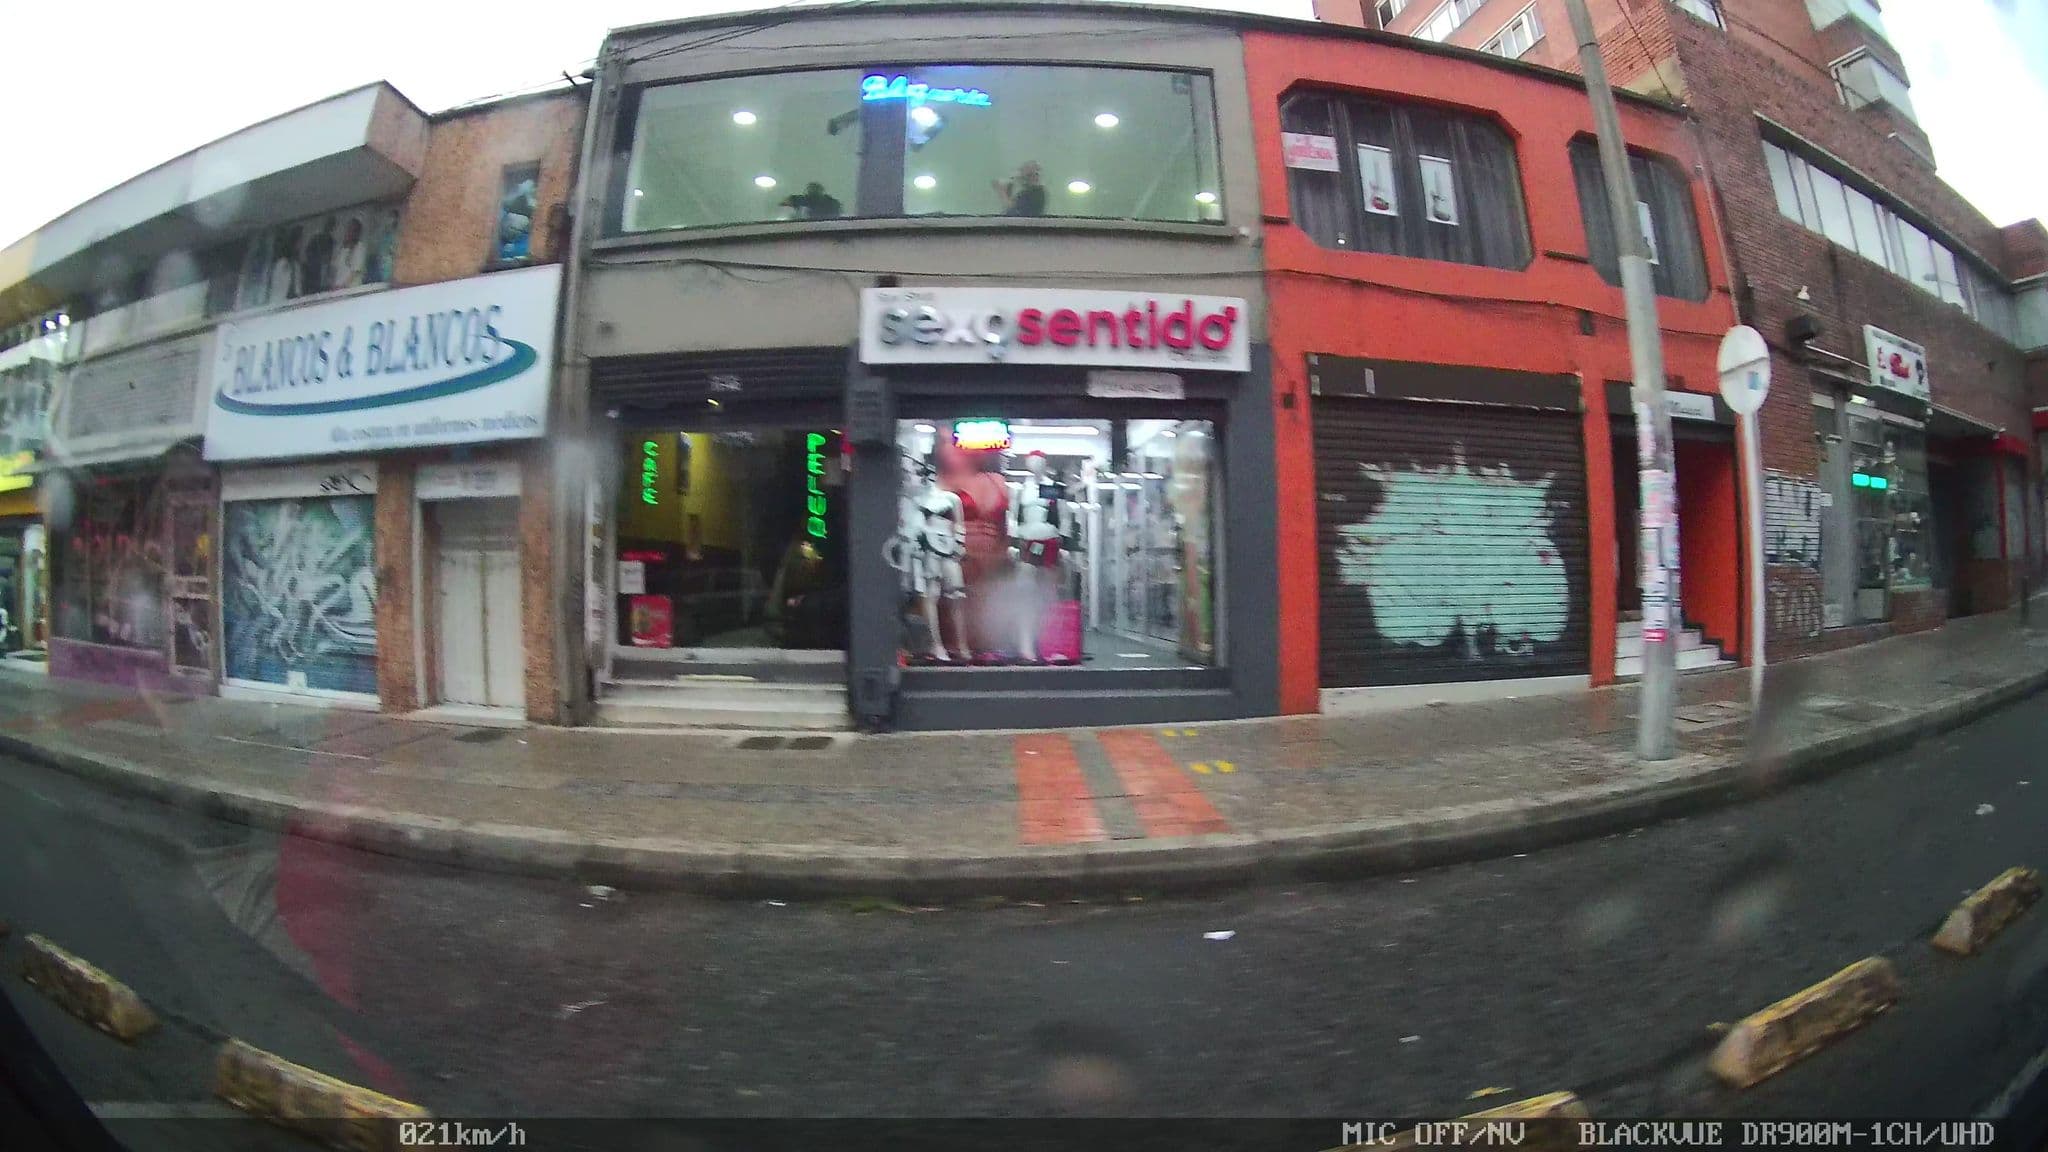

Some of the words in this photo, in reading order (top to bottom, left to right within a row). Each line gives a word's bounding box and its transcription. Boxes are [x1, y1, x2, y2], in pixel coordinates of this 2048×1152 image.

[232, 330, 332, 394] BLANCOS
[336, 325, 354, 379] &
[366, 303, 502, 376] BLANCOS
[1016, 298, 1239, 351] sentido
